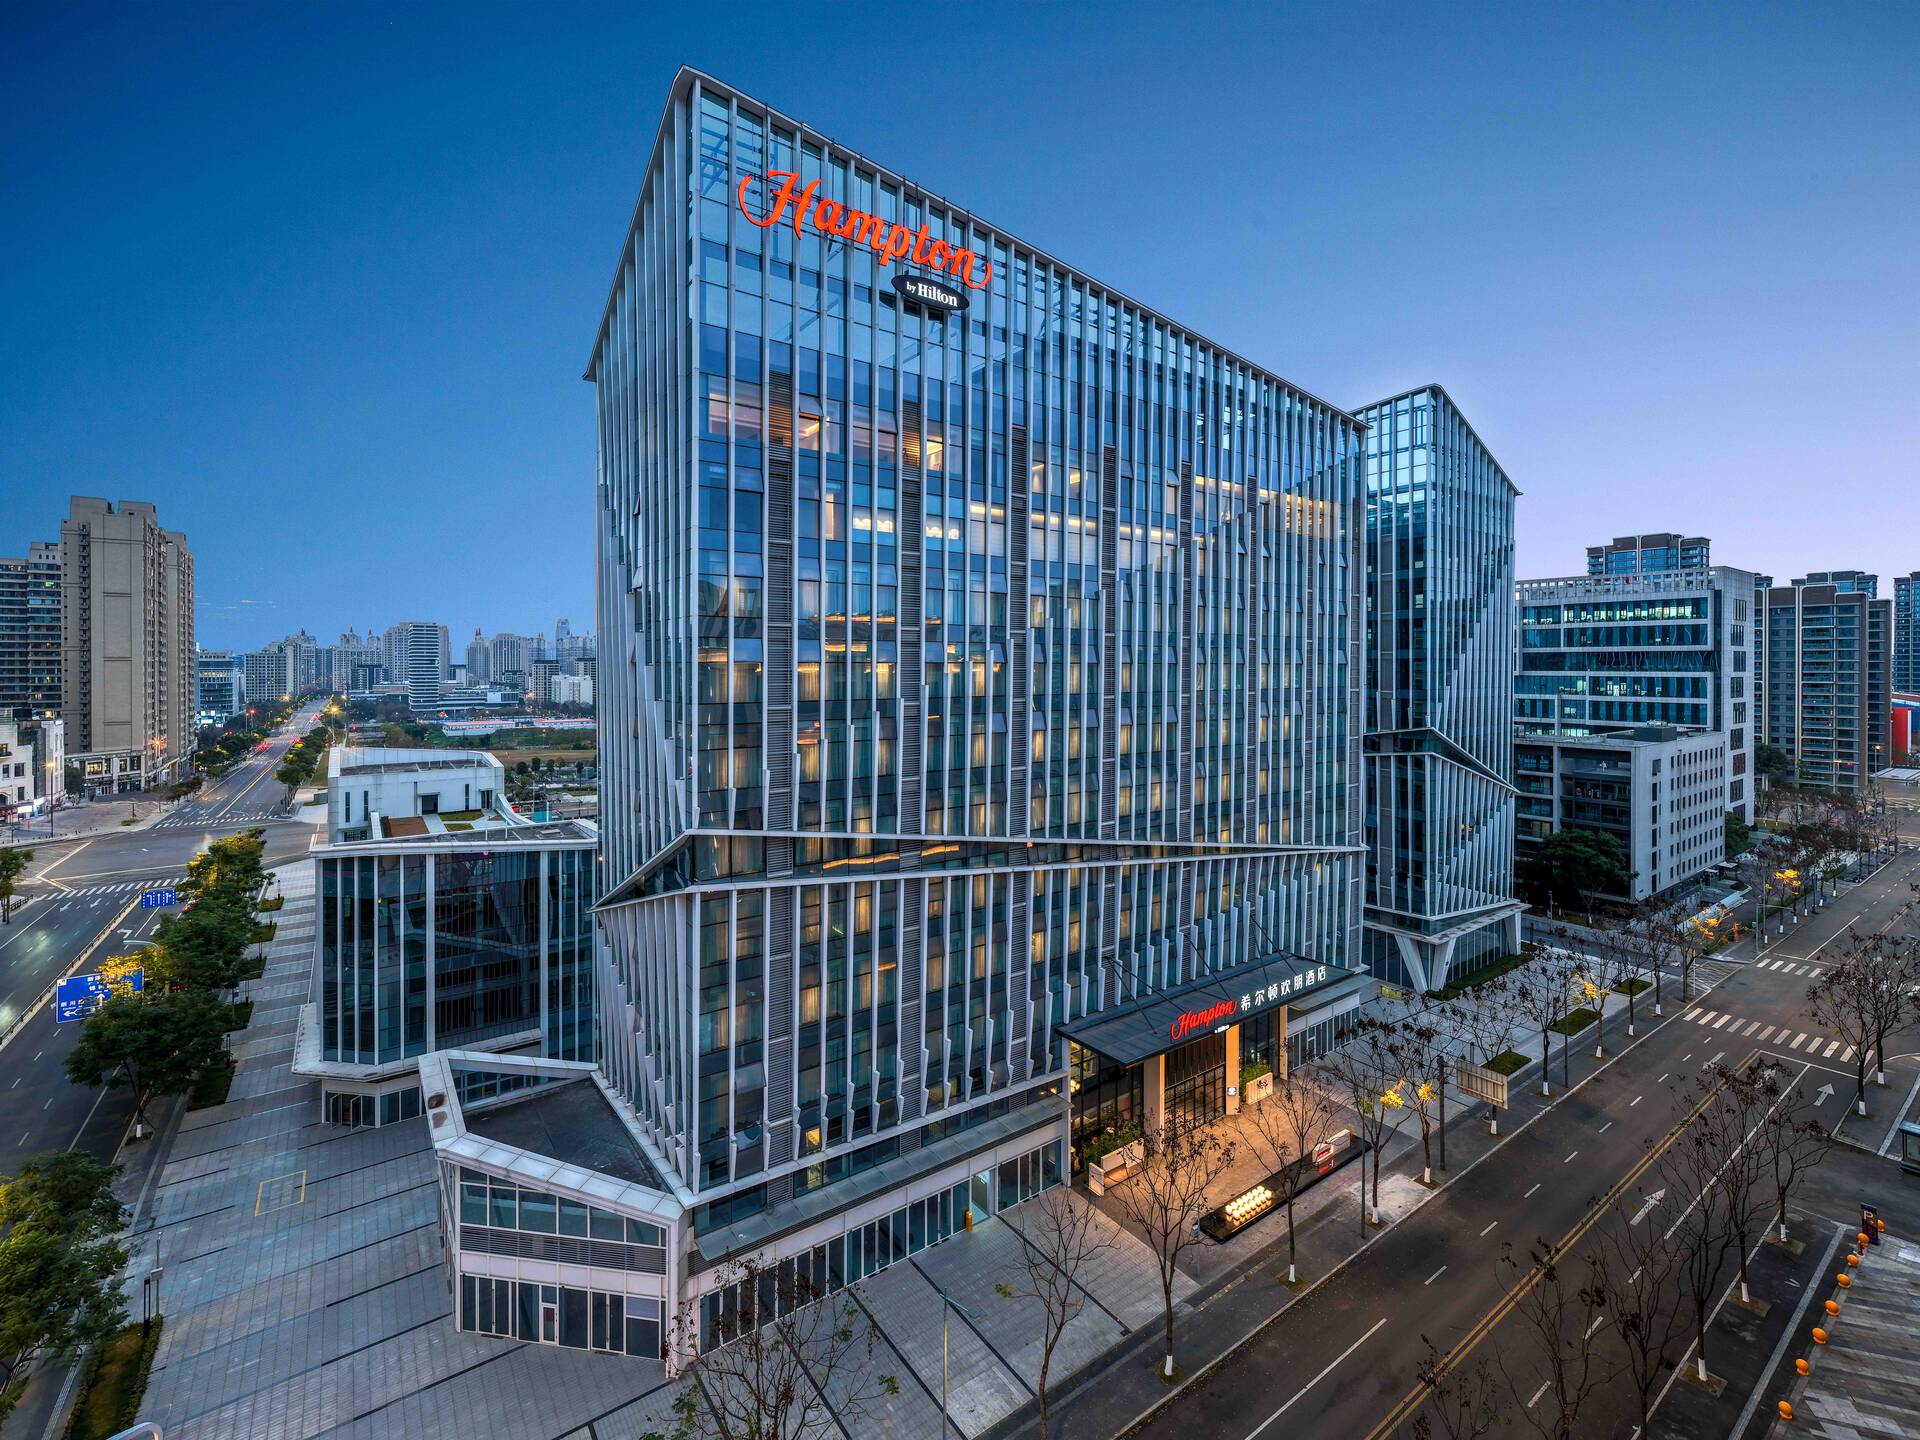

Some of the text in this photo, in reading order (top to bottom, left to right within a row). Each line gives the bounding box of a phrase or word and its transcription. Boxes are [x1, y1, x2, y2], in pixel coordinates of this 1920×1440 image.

[738, 170, 992, 289] Hampton
[906, 281, 958, 307] by Hilton
[1241, 965, 1326, 1011] 希尔顿欢朋酒店
[1171, 1000, 1238, 1041] Hampton
